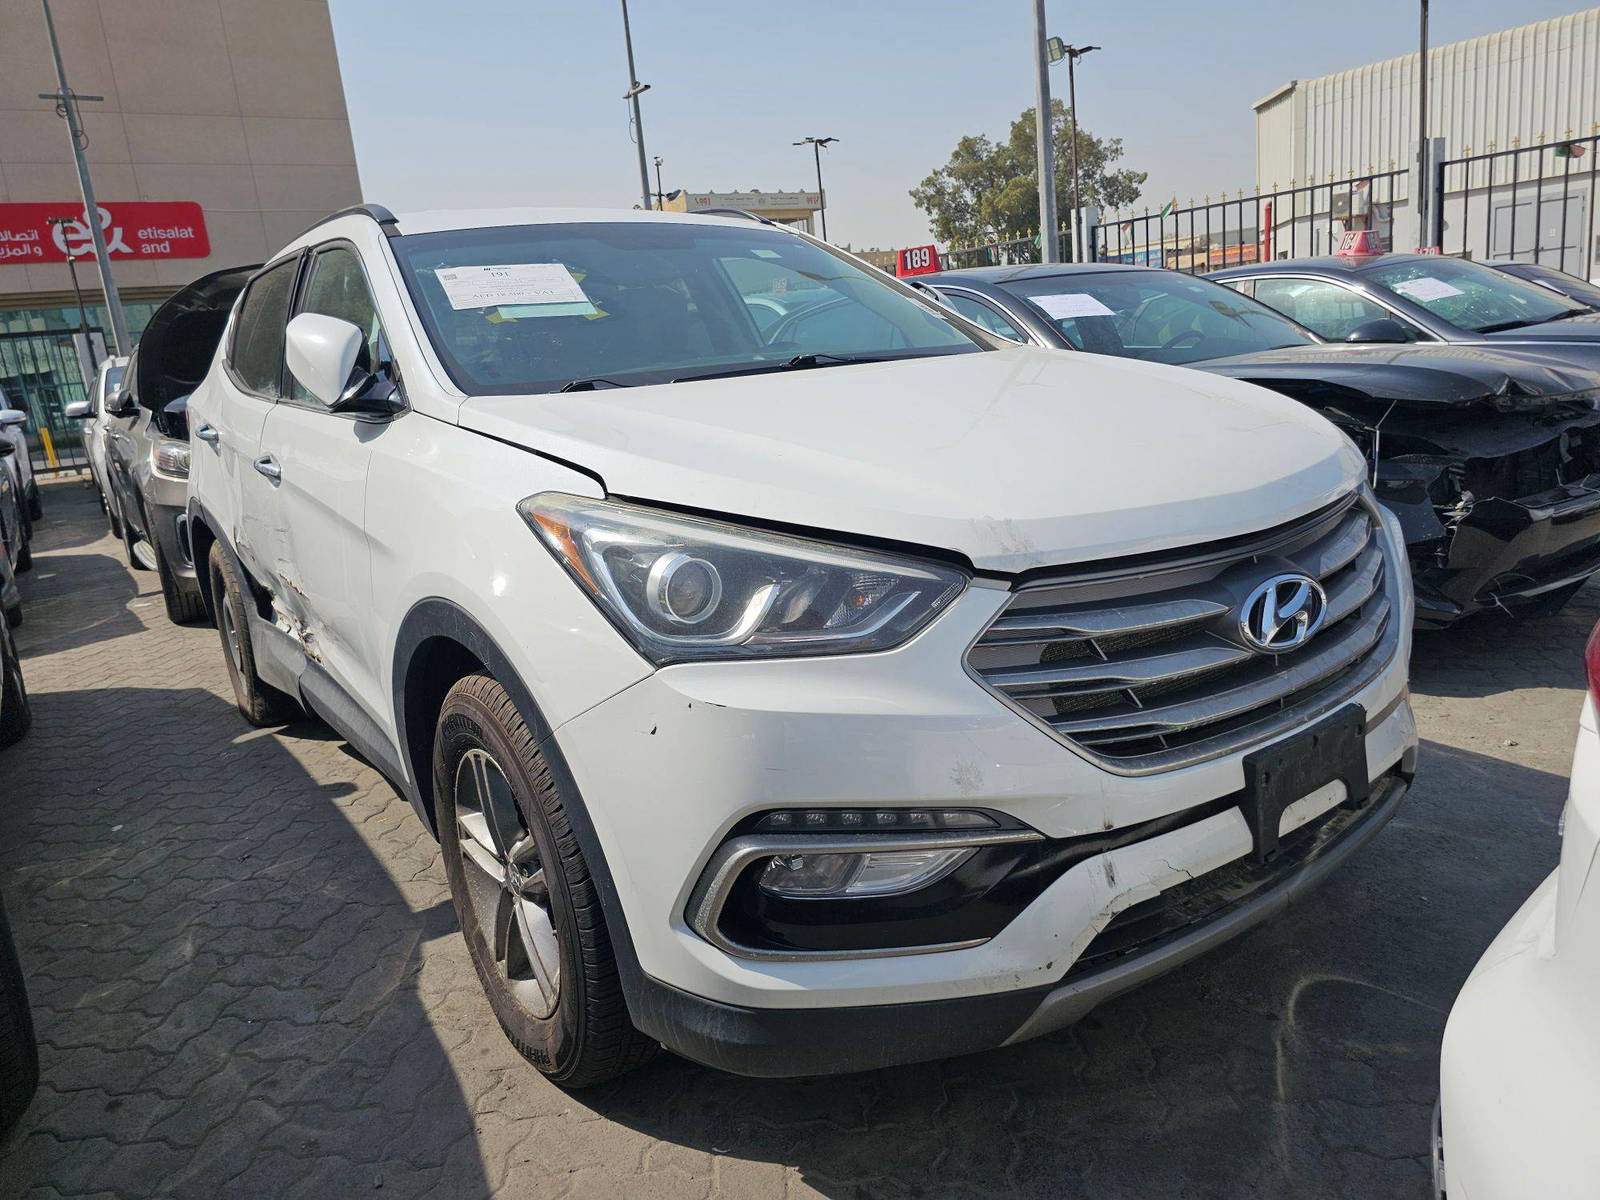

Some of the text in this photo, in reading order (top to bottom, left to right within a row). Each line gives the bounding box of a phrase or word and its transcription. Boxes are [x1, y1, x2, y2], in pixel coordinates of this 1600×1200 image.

[138, 226, 195, 240] etisalat
[142, 241, 171, 254] and
[905, 248, 930, 270] 189
